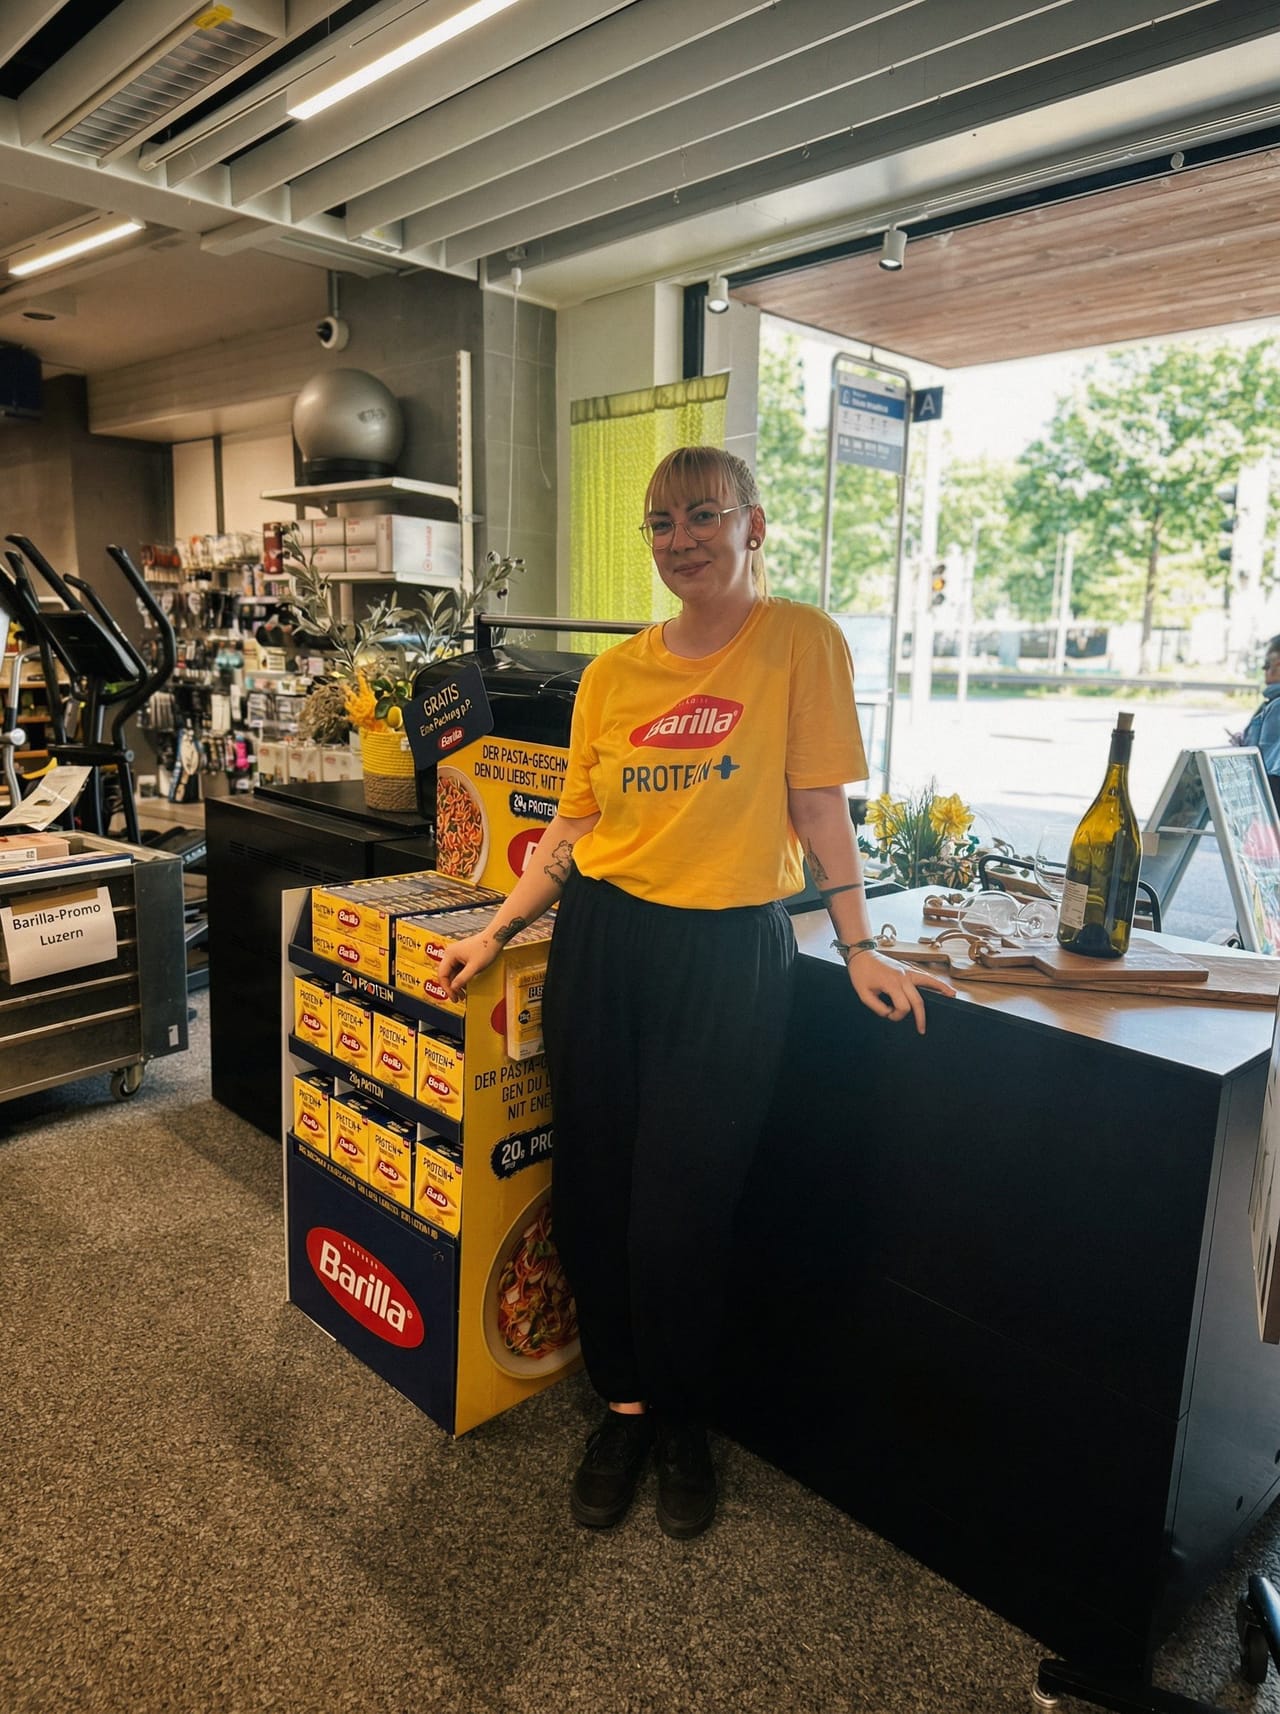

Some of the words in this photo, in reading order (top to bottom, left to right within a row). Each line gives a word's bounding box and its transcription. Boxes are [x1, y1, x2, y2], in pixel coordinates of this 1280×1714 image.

[920, 394, 935, 416] A
[423, 683, 460, 717] GRATIS
[642, 708, 735, 742] Barilla
[482, 744, 499, 760] DER
[474, 762, 491, 778] DEN
[493, 765, 505, 780] DU
[507, 767, 539, 789] LIEBST,
[12, 904, 101, 931] Barilla-Promo
[40, 929, 84, 946] Luzern
[474, 1070, 497, 1092] DER
[527, 1076, 542, 1094] DU
[319, 1240, 407, 1333] Barilla
